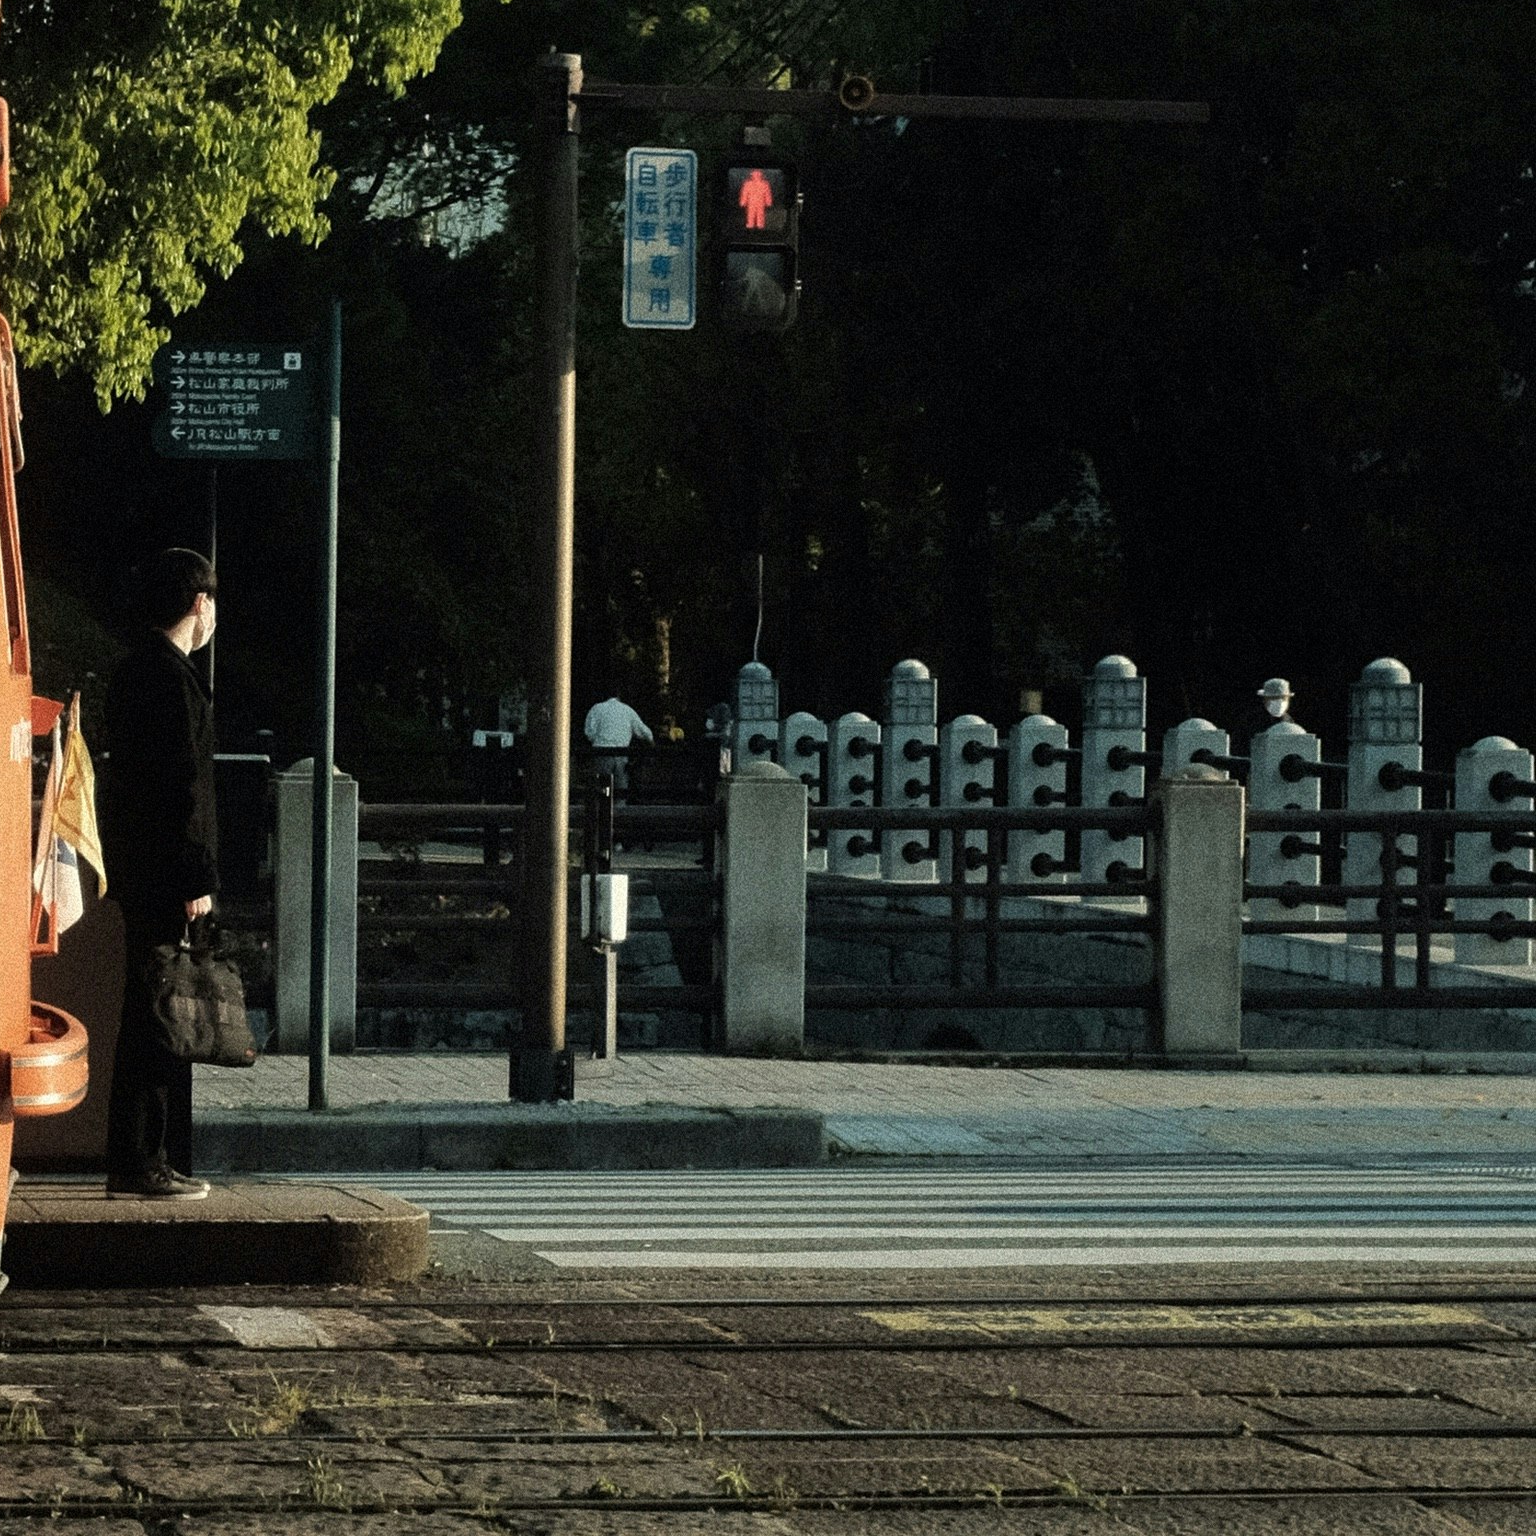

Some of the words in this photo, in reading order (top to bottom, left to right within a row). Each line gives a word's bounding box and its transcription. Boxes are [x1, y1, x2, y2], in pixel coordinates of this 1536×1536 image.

[634, 162, 659, 246] 自転車
[663, 162, 688, 247] 歩行者
[648, 253, 673, 314] 専用
[186, 428, 281, 441] JR松山駅方面
[187, 402, 261, 416] 松山市役所
